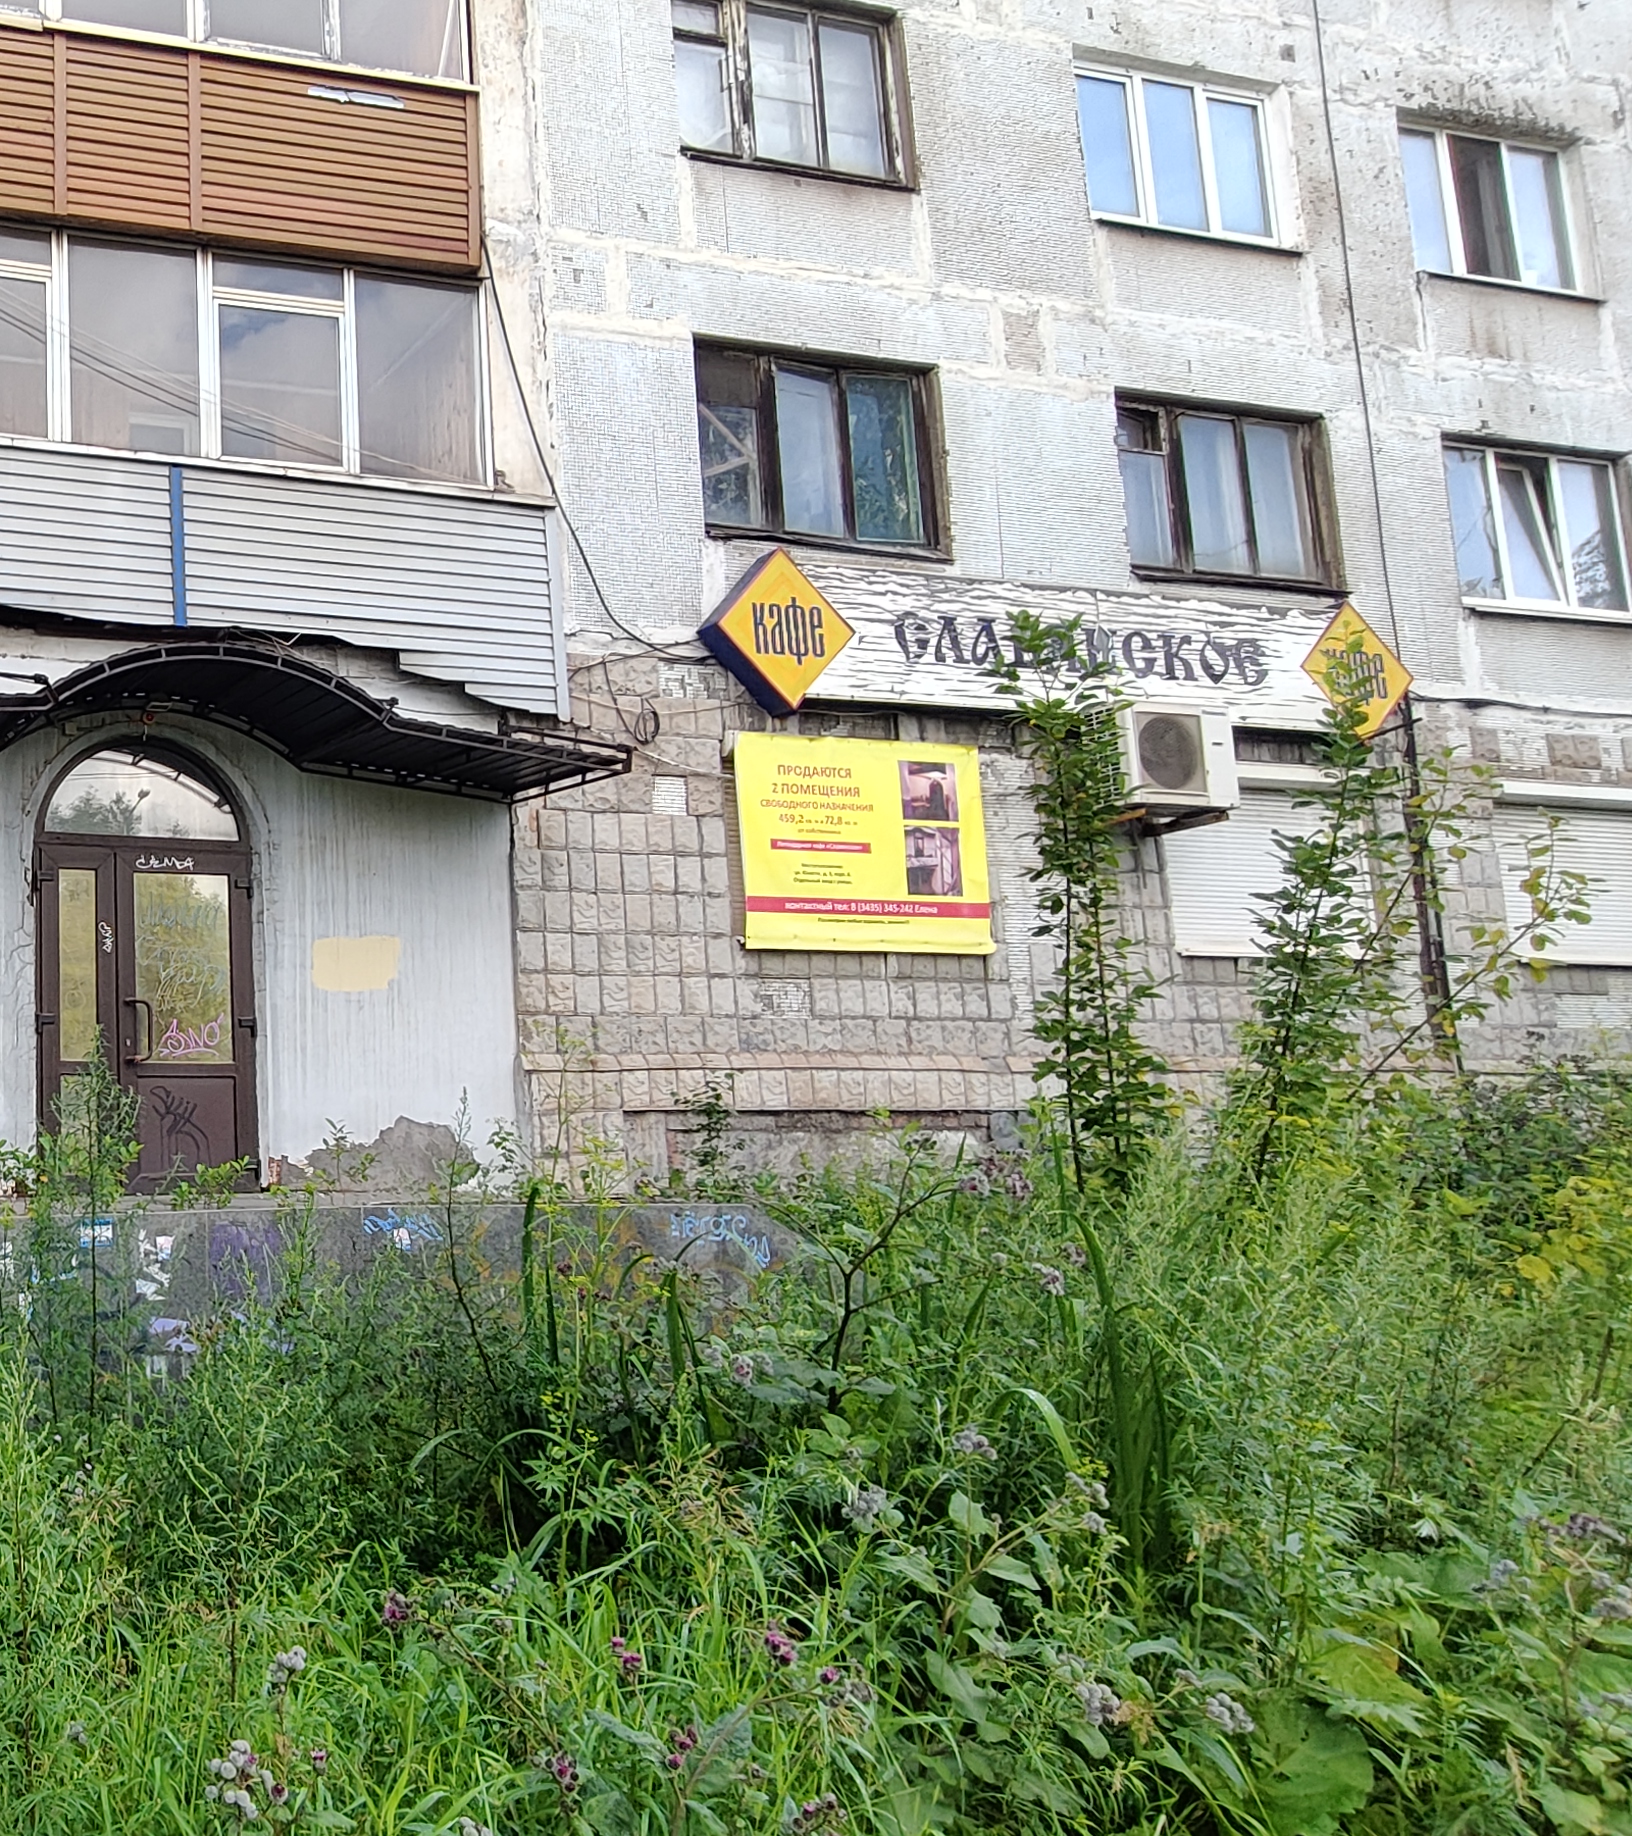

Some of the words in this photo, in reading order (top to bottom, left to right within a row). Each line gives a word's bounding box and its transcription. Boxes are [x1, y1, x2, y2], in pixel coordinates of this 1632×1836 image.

[751, 596, 825, 666] кафе
[777, 764, 852, 779] ПРОДАЮТСЯ
[771, 782, 779, 794] 2
[781, 783, 860, 798] ПОМЕЩЕНИЯ
[760, 799, 819, 810] СВОБОДНОГО
[820, 803, 874, 812] НАЗНАЧЕНИЯ
[779, 814, 804, 825] 459,2
[824, 815, 843, 826] 72,8
[784, 901, 833, 911] контактный
[850, 902, 857, 912] 8
[857, 902, 883, 914] (3435)
[915, 904, 938, 914] Елена
